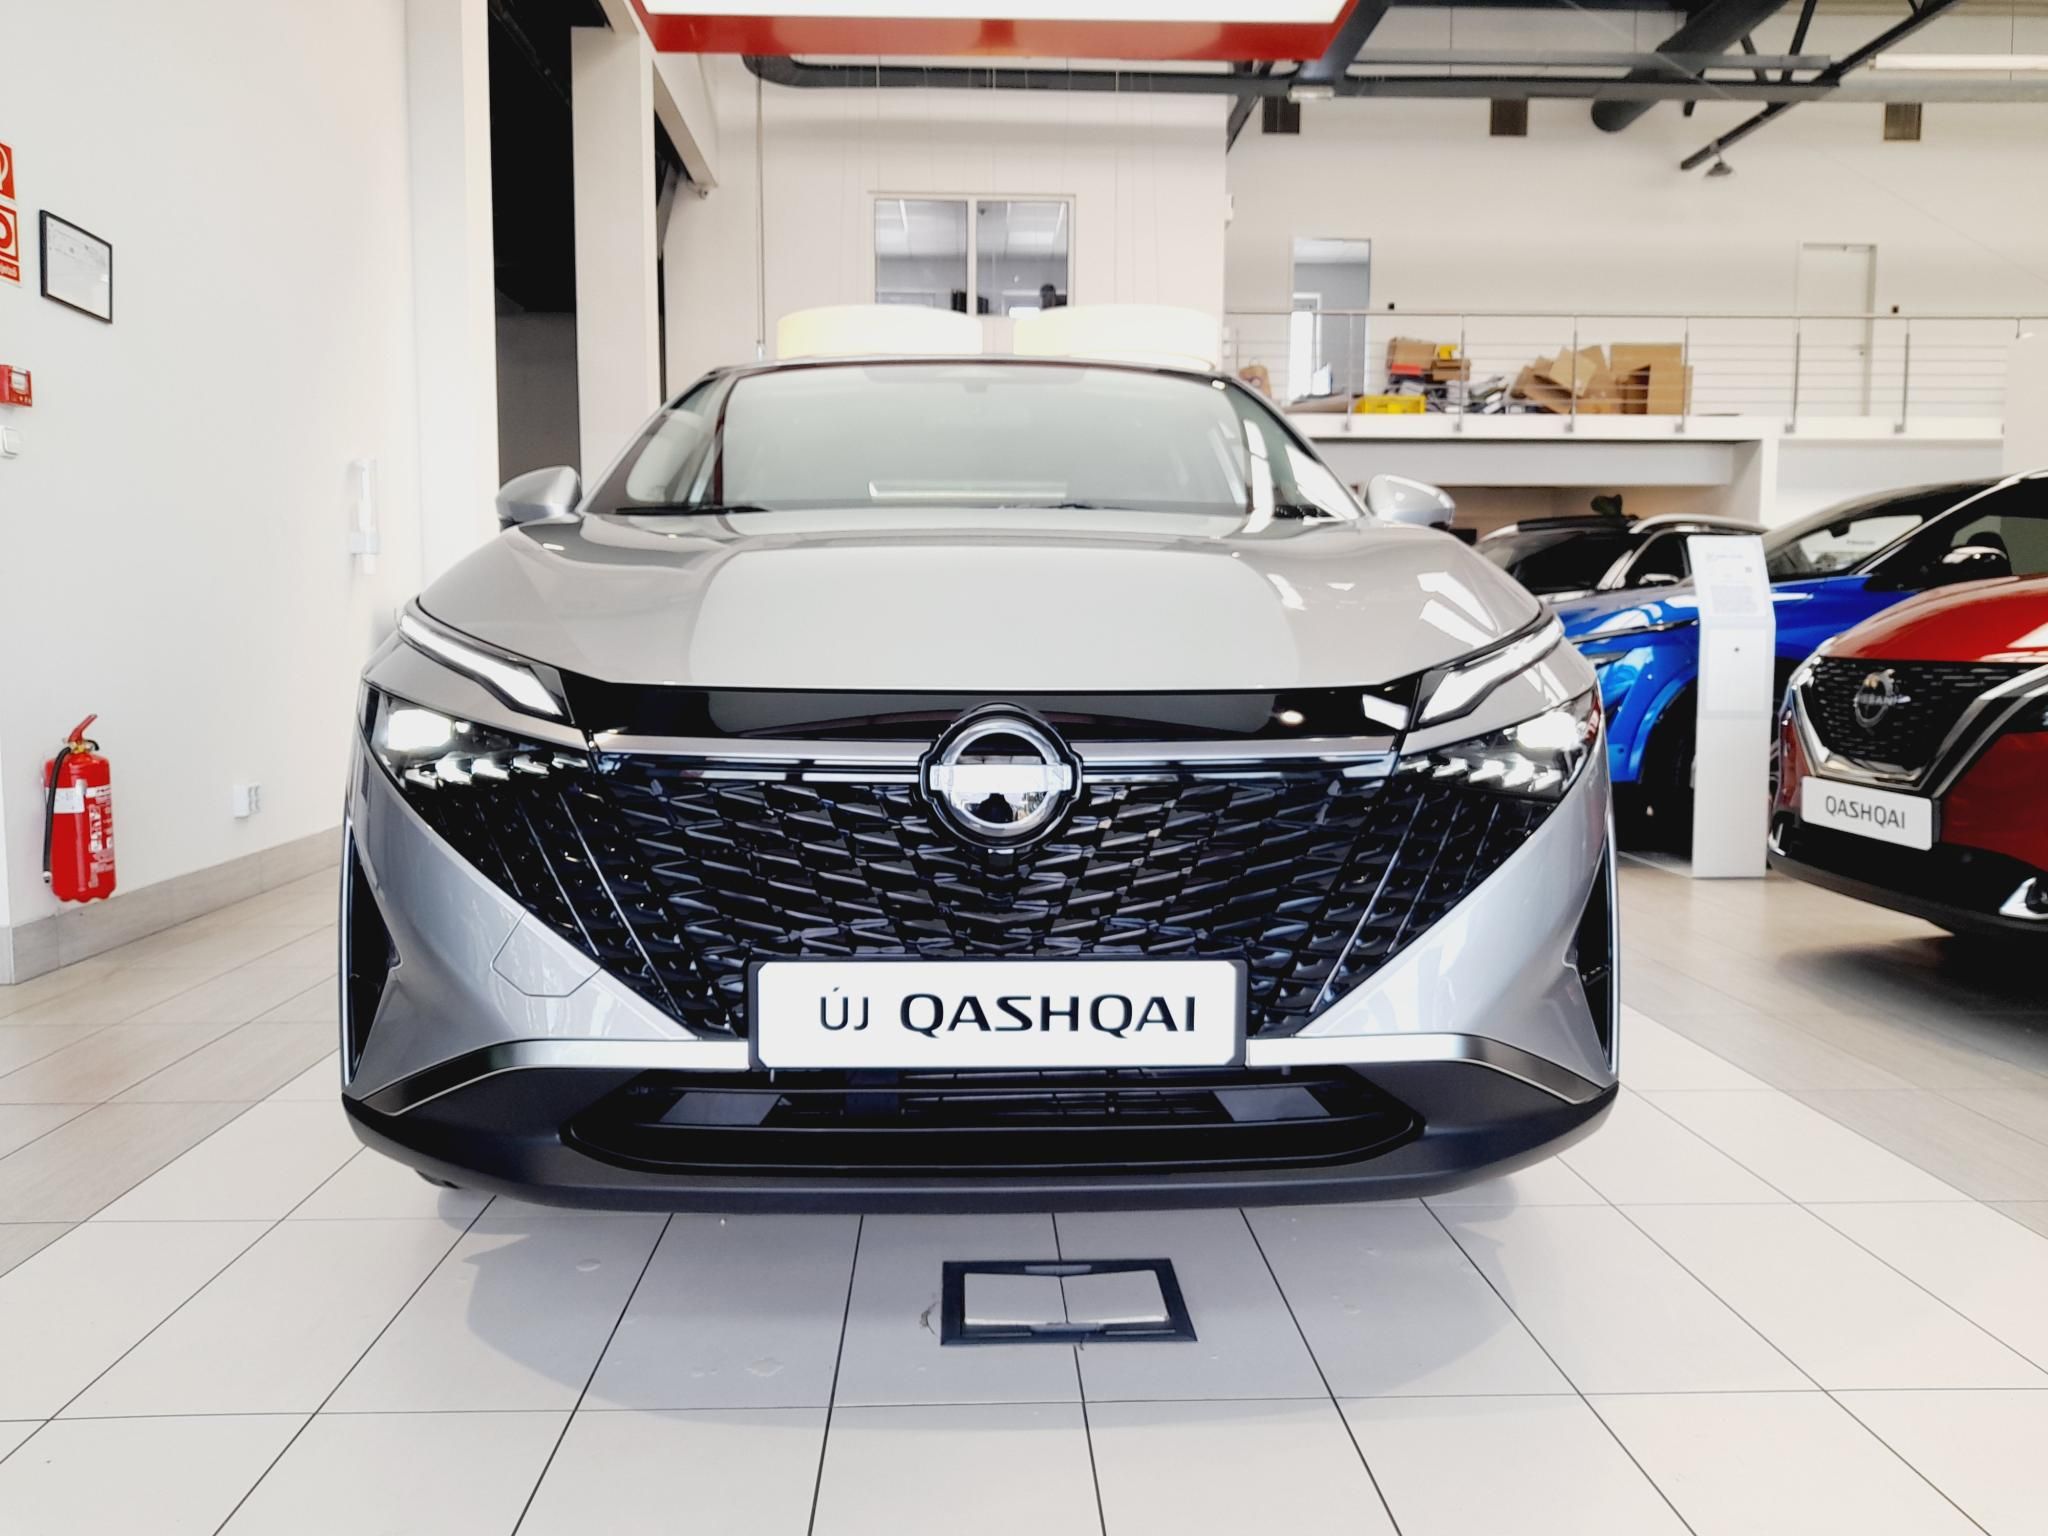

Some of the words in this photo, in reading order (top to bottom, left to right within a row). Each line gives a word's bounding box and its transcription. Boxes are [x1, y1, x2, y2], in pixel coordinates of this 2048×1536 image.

[1825, 795, 1905, 829] QASHQAI
[820, 987, 869, 1031] ÚJ
[900, 994, 1195, 1038] QASHQAI
